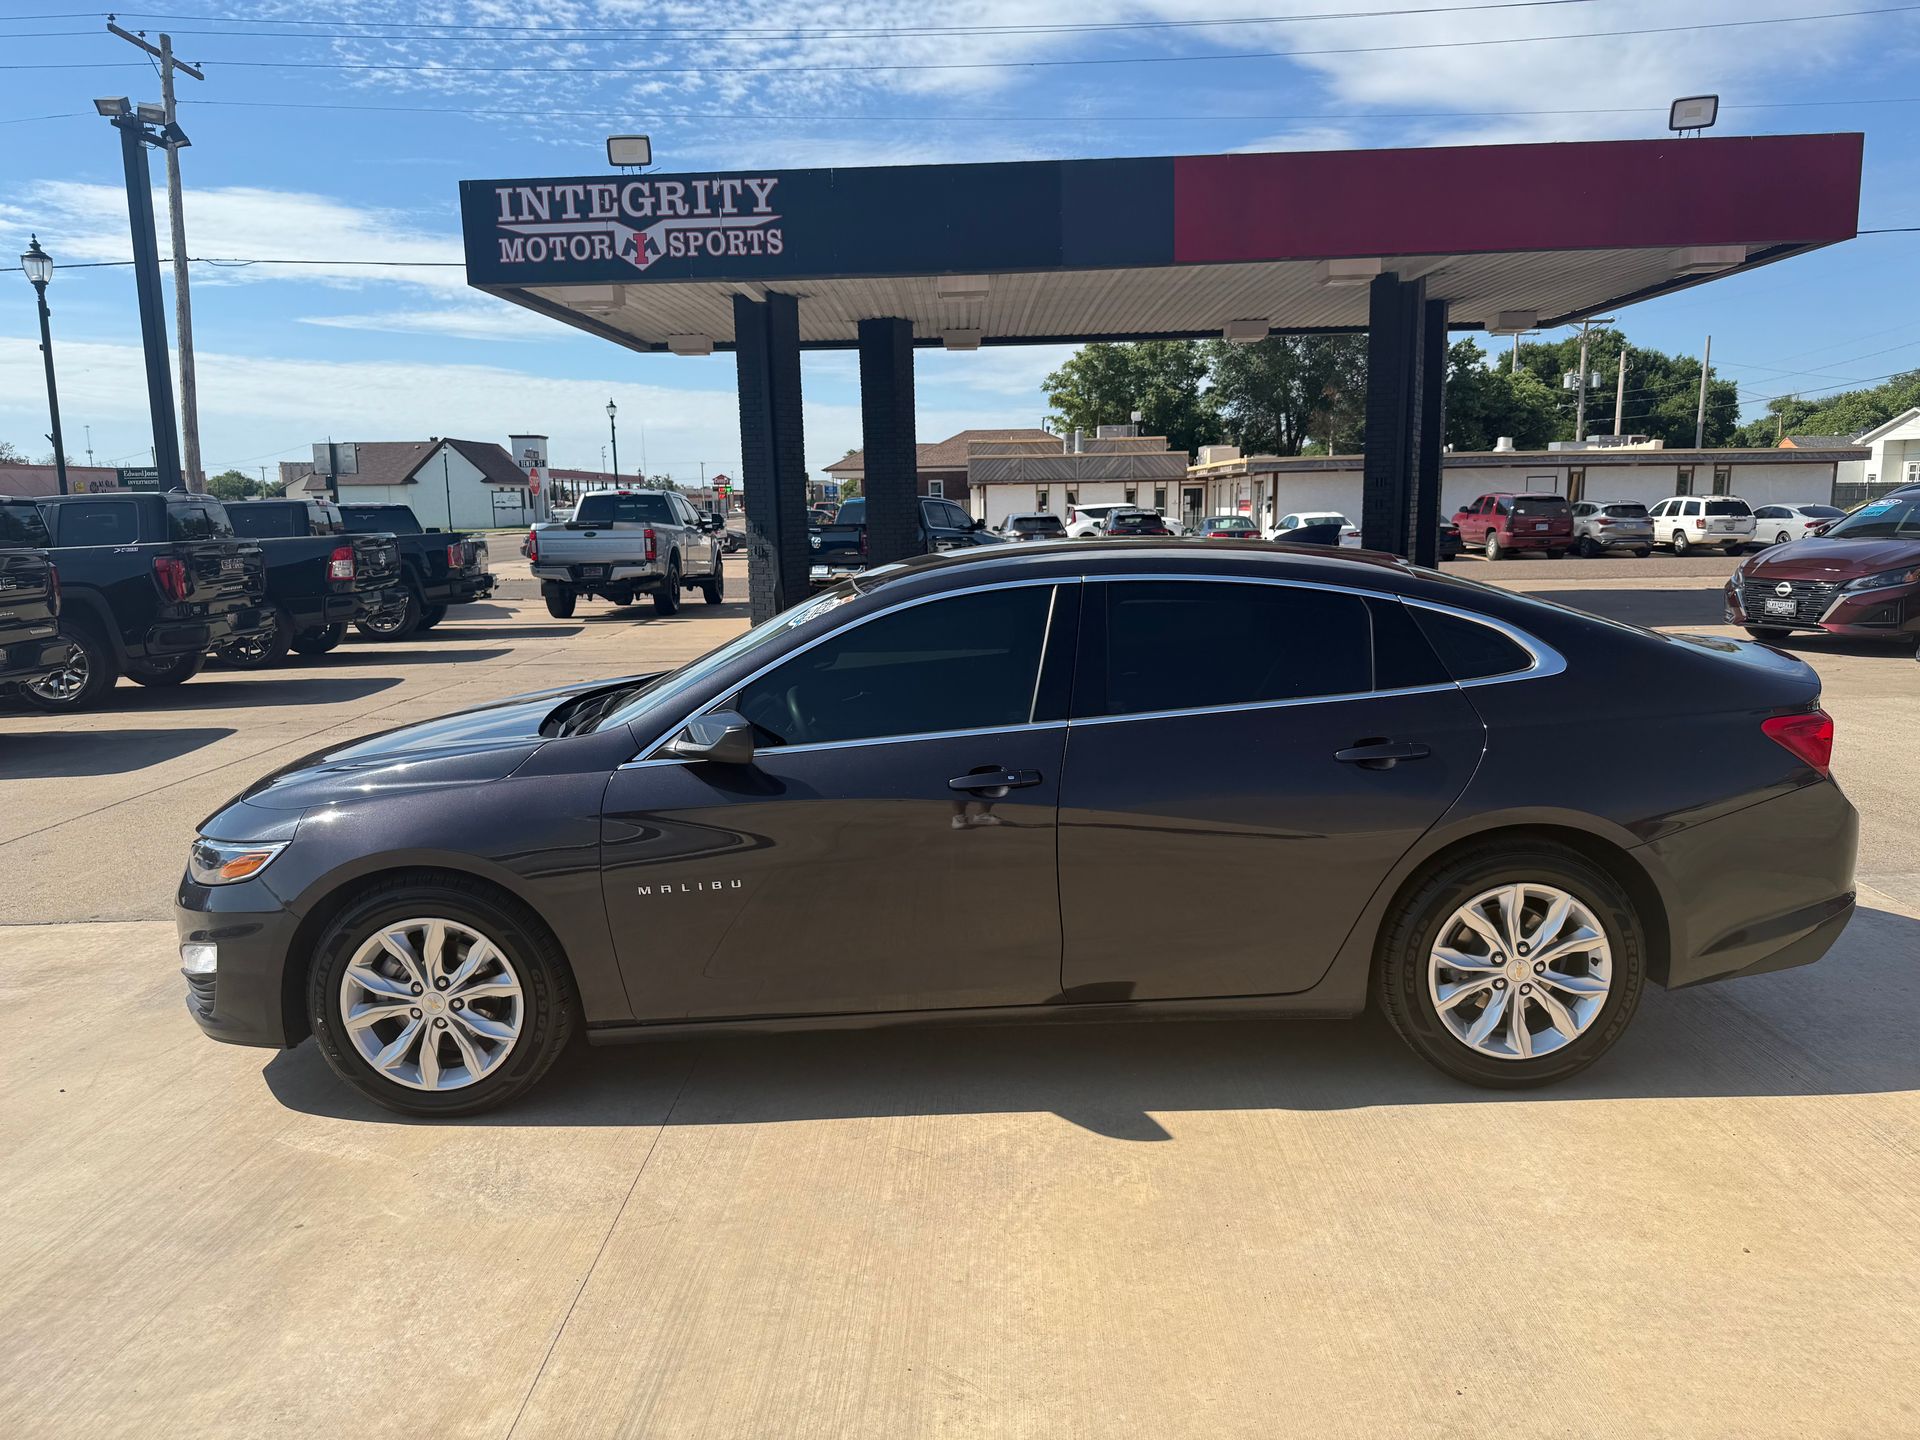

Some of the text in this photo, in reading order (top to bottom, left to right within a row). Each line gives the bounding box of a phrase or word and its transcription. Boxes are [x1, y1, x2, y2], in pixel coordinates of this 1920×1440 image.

[496, 178, 778, 222] INTEGRITY
[499, 235, 613, 262] MOTOR
[669, 229, 784, 258] SPORTS
[530, 476, 540, 487] STOP
[637, 879, 742, 896] MALIBU
[1603, 930, 1639, 1041] IRONMAN
